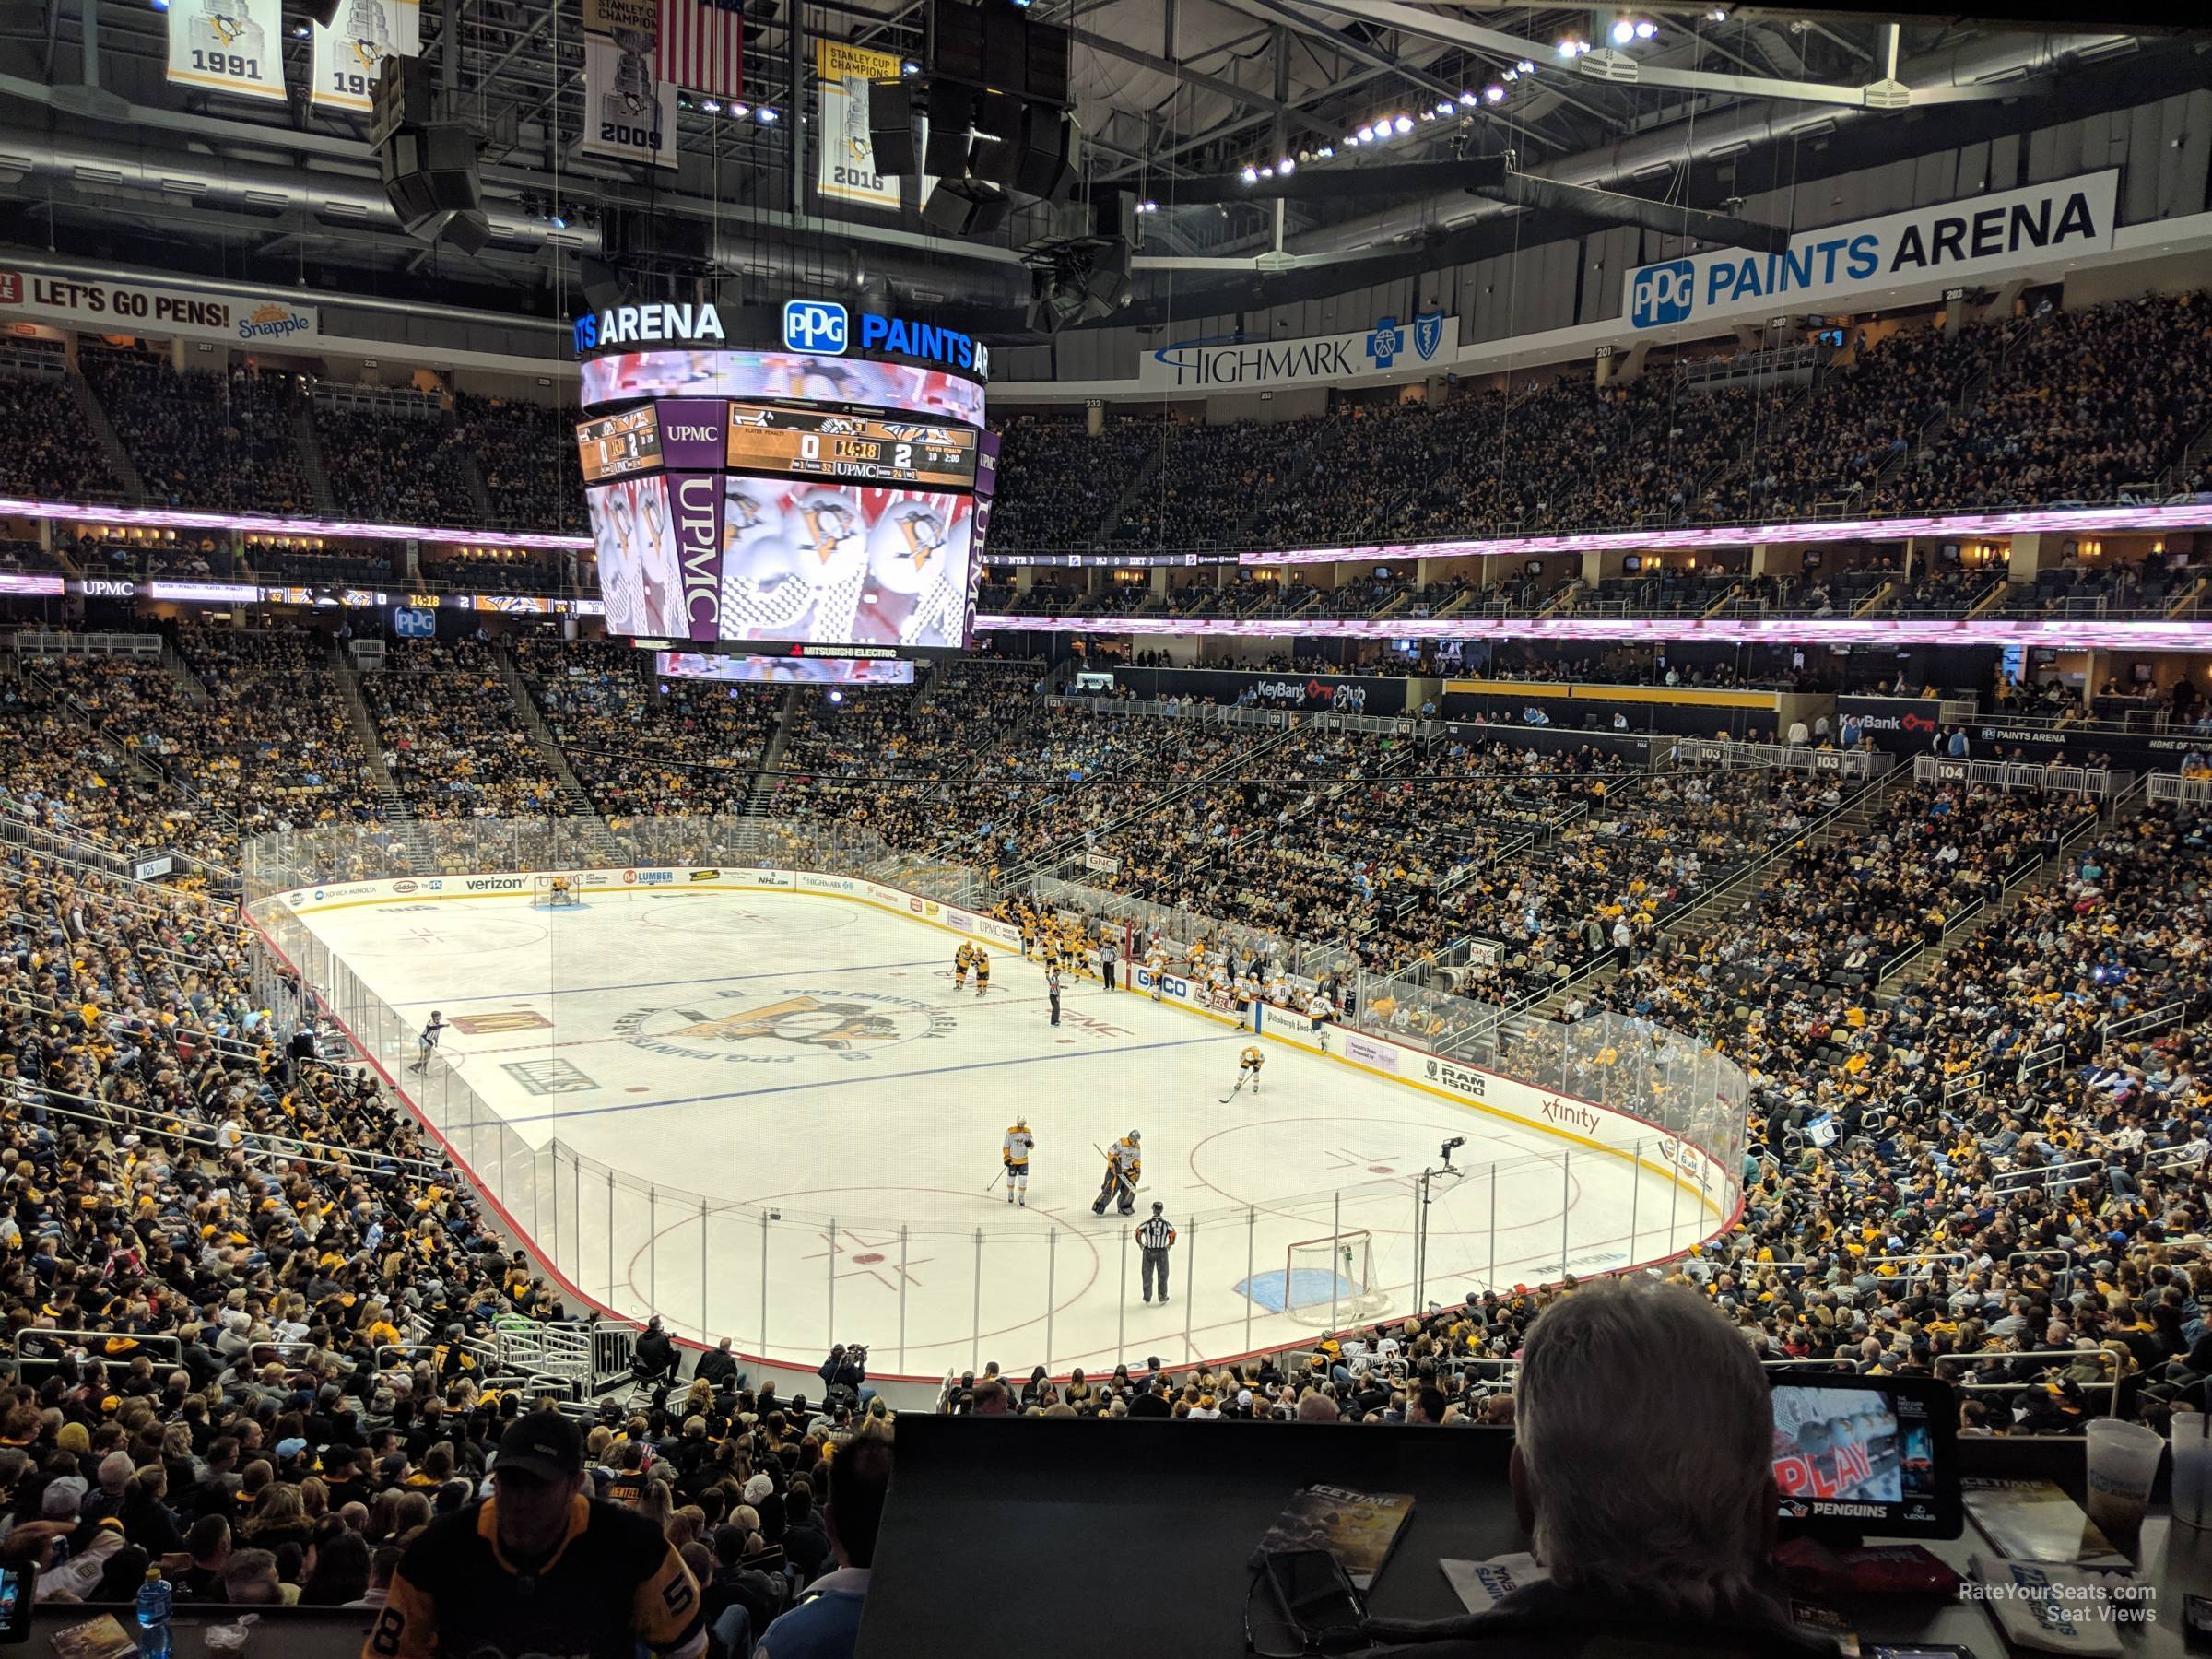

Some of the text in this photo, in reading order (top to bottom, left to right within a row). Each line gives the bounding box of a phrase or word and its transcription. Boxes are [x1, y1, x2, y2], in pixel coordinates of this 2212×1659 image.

[192, 49, 263, 80] 1991
[830, 47, 890, 69] STANLEY CUP
[830, 58, 890, 80] CHAMPIONS
[601, 122, 663, 150] 2009
[834, 166, 885, 192] 2016
[1633, 192, 2097, 322] PPG PAINTS ARENA
[34, 278, 106, 312] LET'S
[112, 290, 148, 318] GO
[156, 296, 230, 328] PENS!
[238, 313, 310, 340] Snapple
[599, 303, 725, 346] ARENA
[788, 307, 844, 347] PPG
[1772, 317, 1787, 327] 202
[862, 312, 972, 369] PAINTS
[1597, 346, 1612, 358] 201
[1176, 339, 1354, 386] HIGHMARK
[1086, 400, 1101, 408] 232
[667, 425, 719, 441] UPMC
[599, 441, 609, 464] 0
[629, 433, 639, 457] 2
[801, 434, 912, 468] 0 14:18 2
[928, 452, 959, 463] 10 2:00
[980, 453, 996, 471] UPMC
[821, 462, 832, 472] 32
[837, 463, 876, 477] UPMC
[892, 469, 902, 478] 24
[678, 477, 720, 625] UPMC
[994, 556, 1000, 564] 2
[1008, 556, 1027, 565] NYR
[1030, 556, 1035, 565] 3
[1052, 556, 1057, 565] 3
[1096, 556, 1174, 565] NJ 0 DET 2 2
[81, 581, 134, 596] UPMC
[271, 593, 282, 603] 32
[377, 593, 470, 608] 0 14:18 2
[397, 609, 434, 633] PPG
[803, 646, 897, 659] MITSUBISHI ELECTRIC
[1257, 680, 1306, 700] KeyBank
[1270, 714, 1281, 724] 122
[1329, 718, 1340, 729] 101
[1398, 724, 1411, 734] 101
[1997, 730, 2031, 741] PAINTS
[2032, 734, 2066, 744] ARENA
[1700, 747, 1721, 759] 103
[2149, 740, 2189, 751] HOME OF
[1816, 756, 1839, 770] 103
[1939, 765, 1964, 779] 104
[143, 865, 155, 876] IGS
[638, 871, 673, 880] LUMBER
[393, 882, 418, 891] Glidden
[465, 877, 523, 892] verizon
[806, 877, 841, 889] HIGHMARK
[348, 887, 377, 896] MINOLTA
[979, 920, 1001, 937] UPMC
[1137, 969, 1187, 998] GCO
[1267, 1011, 1296, 1030] Pittsburgh
[1441, 1067, 1486, 1088] RAM
[1441, 1077, 1485, 1097] 1500
[1541, 1098, 1601, 1135] xfinity
[1681, 1155, 1698, 1170] Gulf
[1153, 1227, 1161, 1237] 15
[1771, 1441, 1872, 1500] PLAY
[1309, 1482, 1400, 1508] ICETIME
[1812, 1501, 1888, 1519] PENGUINS
[1903, 1512, 1936, 1522] LEXUS
[662, 1573, 696, 1618] 5
[372, 1606, 406, 1657] 8
